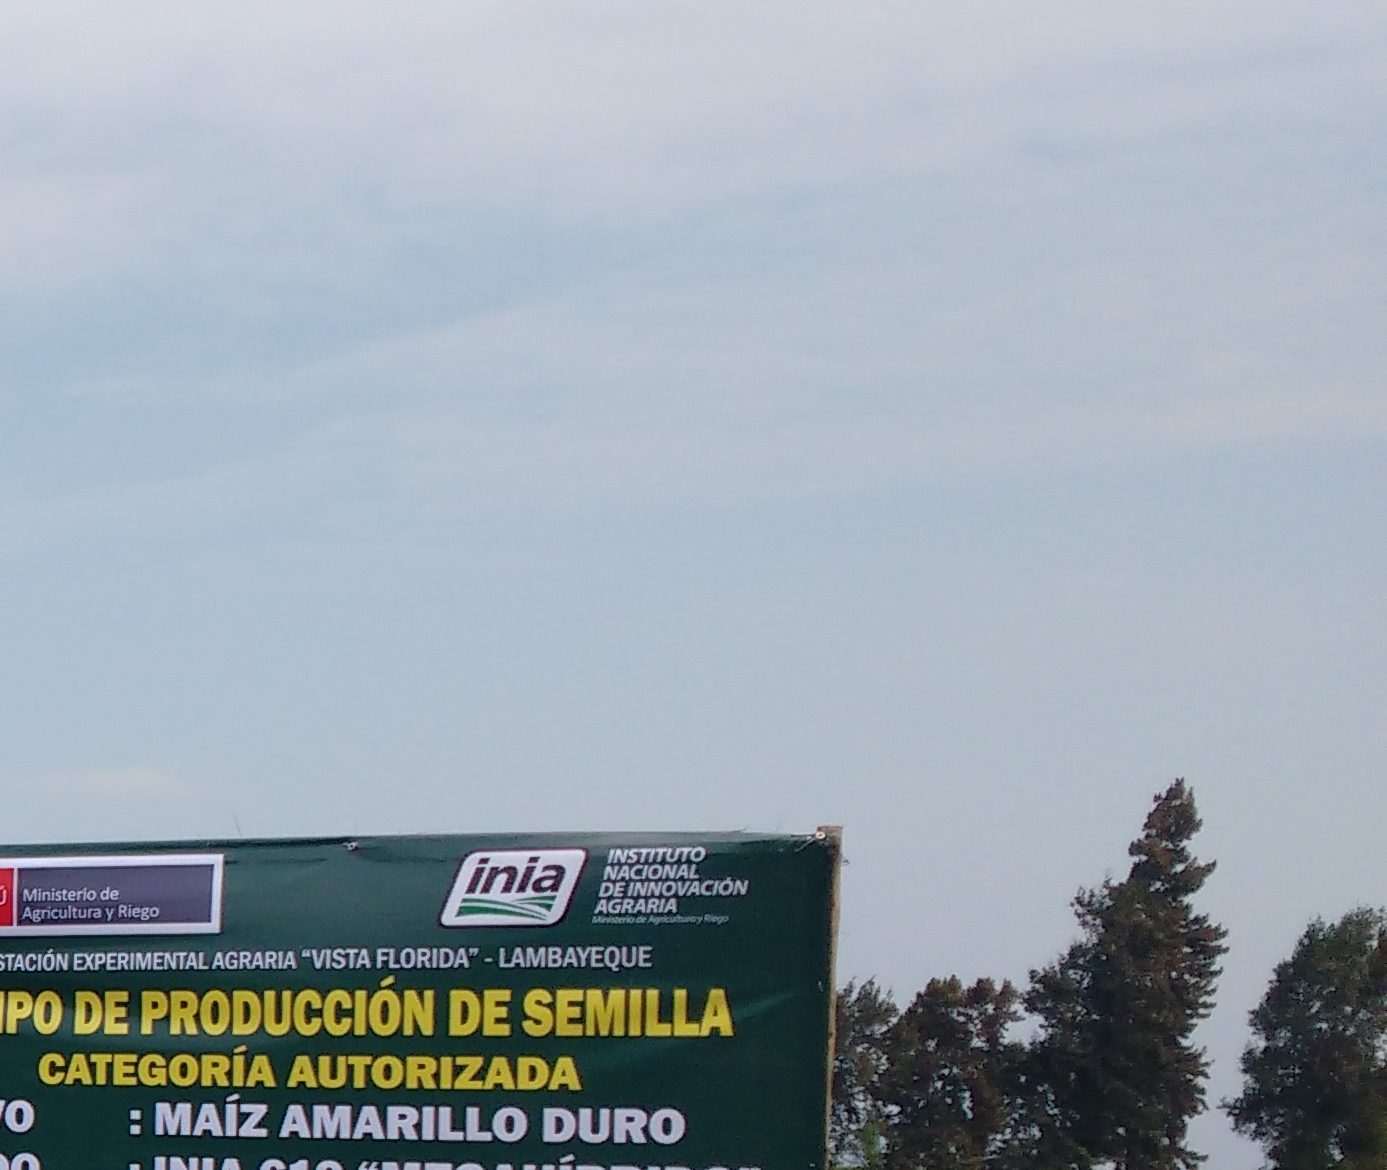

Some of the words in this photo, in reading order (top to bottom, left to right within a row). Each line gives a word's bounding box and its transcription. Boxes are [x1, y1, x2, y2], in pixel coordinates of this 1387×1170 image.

[606, 846, 707, 864] INSTITUTO
[465, 856, 567, 895] inia
[603, 863, 700, 881] NACIONAL
[22, 886, 98, 902] Ministerio
[99, 886, 120, 901] de
[598, 881, 626, 898] DE
[627, 877, 749, 897] INNOVACIÓN
[21, 904, 103, 923] Agricultura
[104, 907, 114, 922] y
[118, 904, 160, 921] Riego
[593, 897, 678, 915] AGRARIA
[73, 950, 210, 971] EXPERIMENTAL
[211, 950, 298, 970] AGRARIA
[301, 947, 372, 970] “VISTA
[376, 947, 480, 969] FLORIDA”
[498, 945, 654, 972] LAMBAYEQUE
[73, 990, 130, 1035] DE
[140, 975, 435, 1037] PRODUCCIÓN
[448, 988, 512, 1037] DE
[521, 987, 734, 1037] SEMILLA
[38, 1044, 277, 1088] CATEGORÍA
[287, 1054, 582, 1091] AUTORIZADA
[129, 1109, 142, 1135] :
[154, 1093, 269, 1138] MAÍZ
[282, 1104, 528, 1143] AMARILLO
[542, 1107, 686, 1145] DURO
